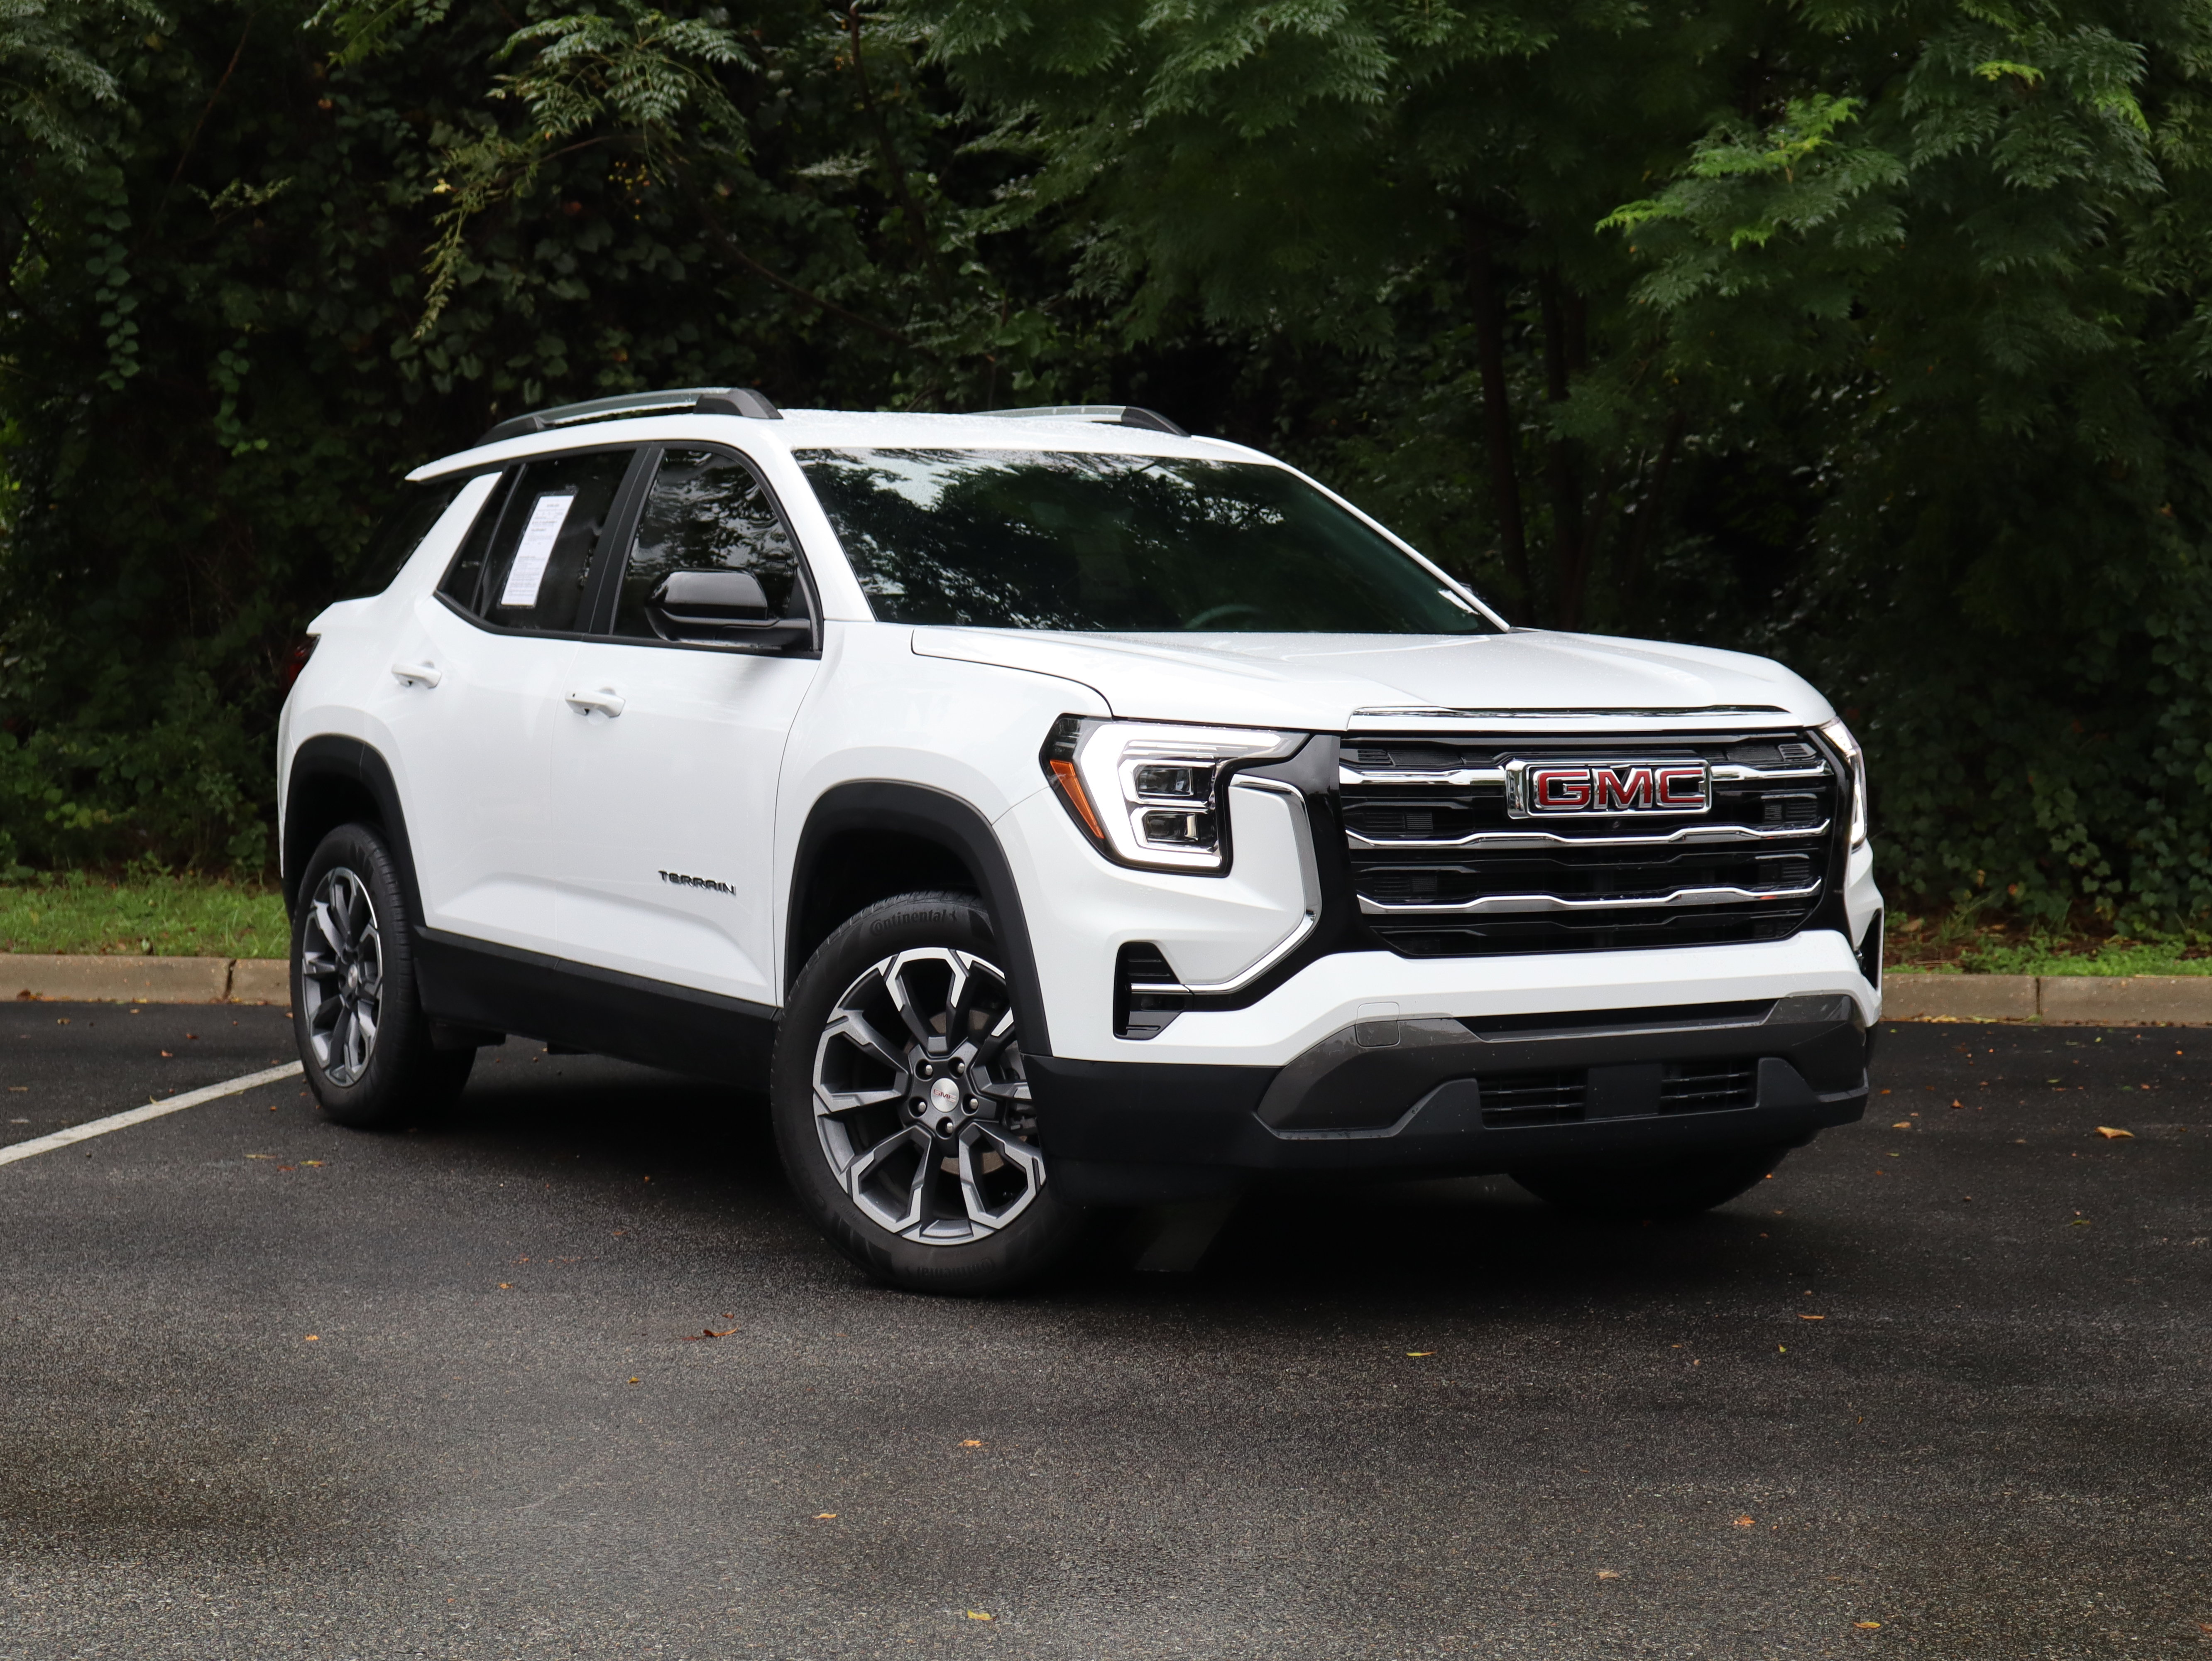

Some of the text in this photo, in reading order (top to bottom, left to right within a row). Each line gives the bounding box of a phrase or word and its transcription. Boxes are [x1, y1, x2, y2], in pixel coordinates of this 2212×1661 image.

[1535, 767, 1705, 810] GMC
[658, 870, 736, 896] TERRAIN
[869, 909, 947, 936] Continental
[934, 1089, 957, 1102] GMC
